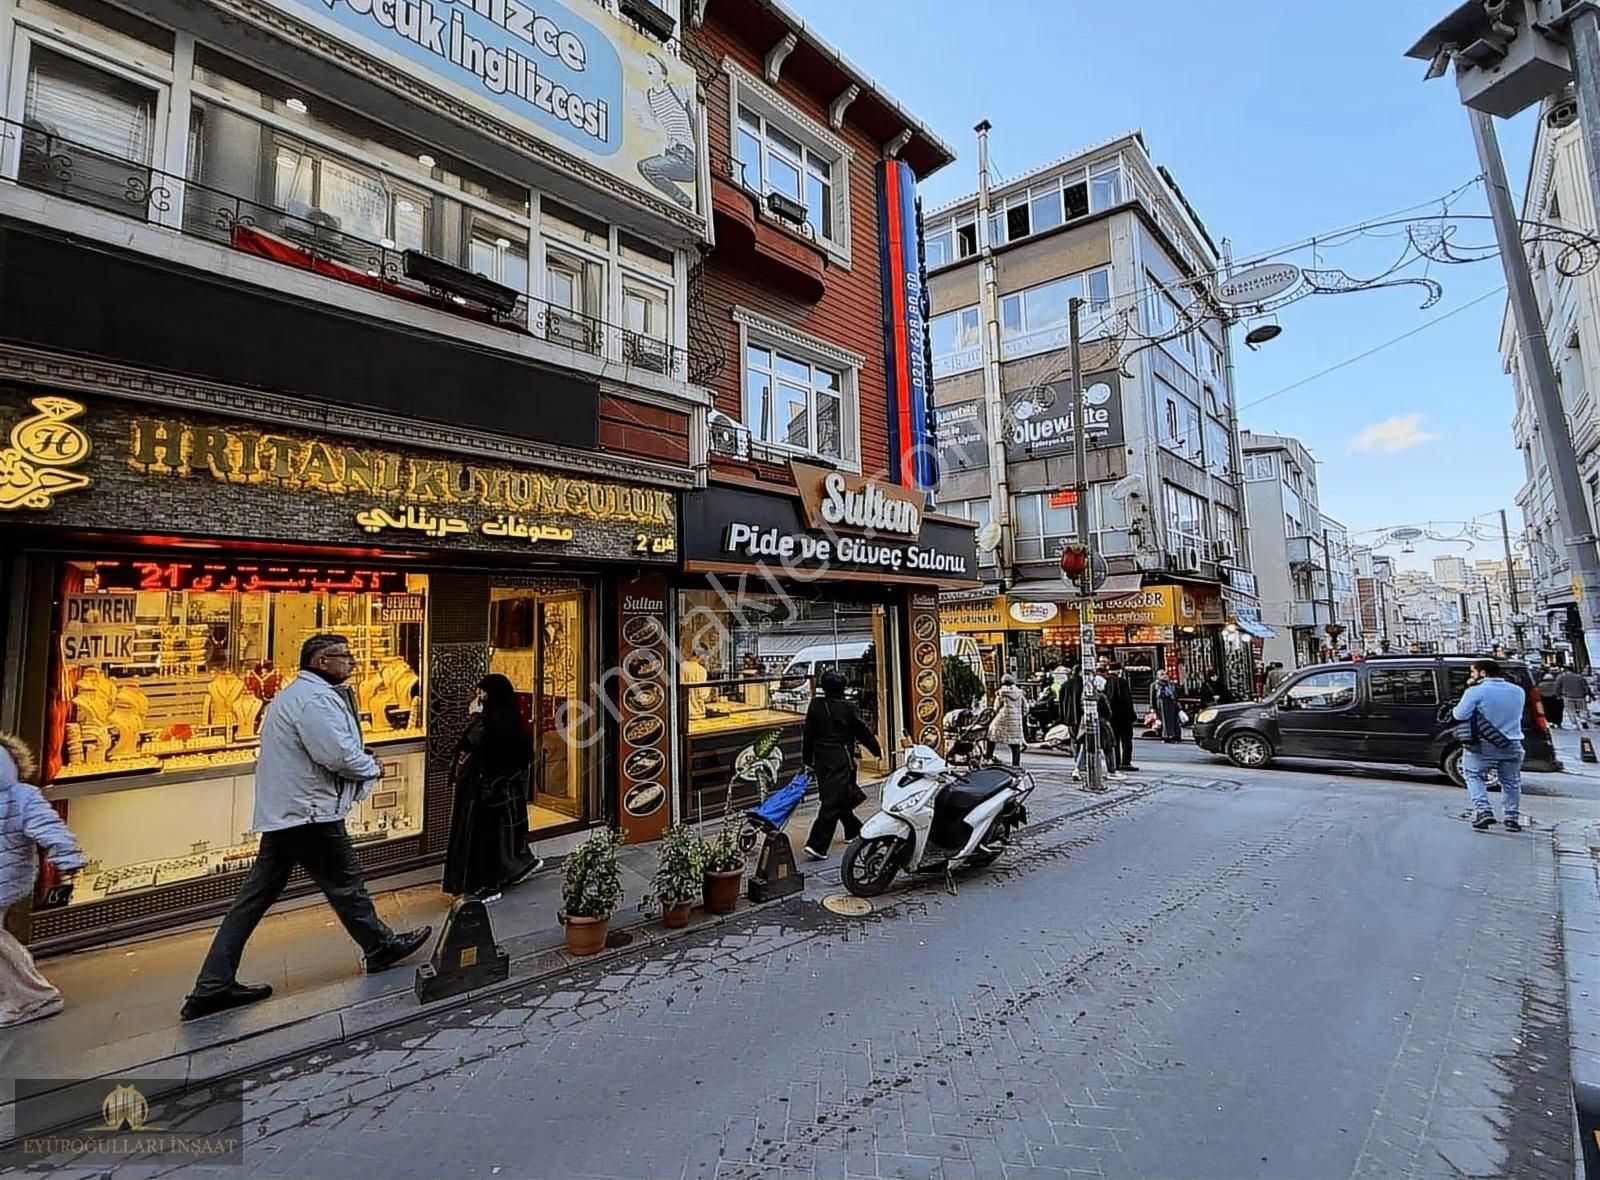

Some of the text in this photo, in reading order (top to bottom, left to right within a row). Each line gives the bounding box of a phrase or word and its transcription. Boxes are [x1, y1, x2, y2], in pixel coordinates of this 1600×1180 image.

[822, 472, 920, 535] Sultan
[481, 514, 573, 543] مصوغات
[636, 533, 674, 553] فرع 2
[728, 523, 967, 573] Pide ve Güveç Salonu
[140, 562, 179, 588] 21
[68, 598, 134, 623] DEVREN
[624, 595, 663, 611] Sultan
[64, 635, 132, 659] SATLIK
